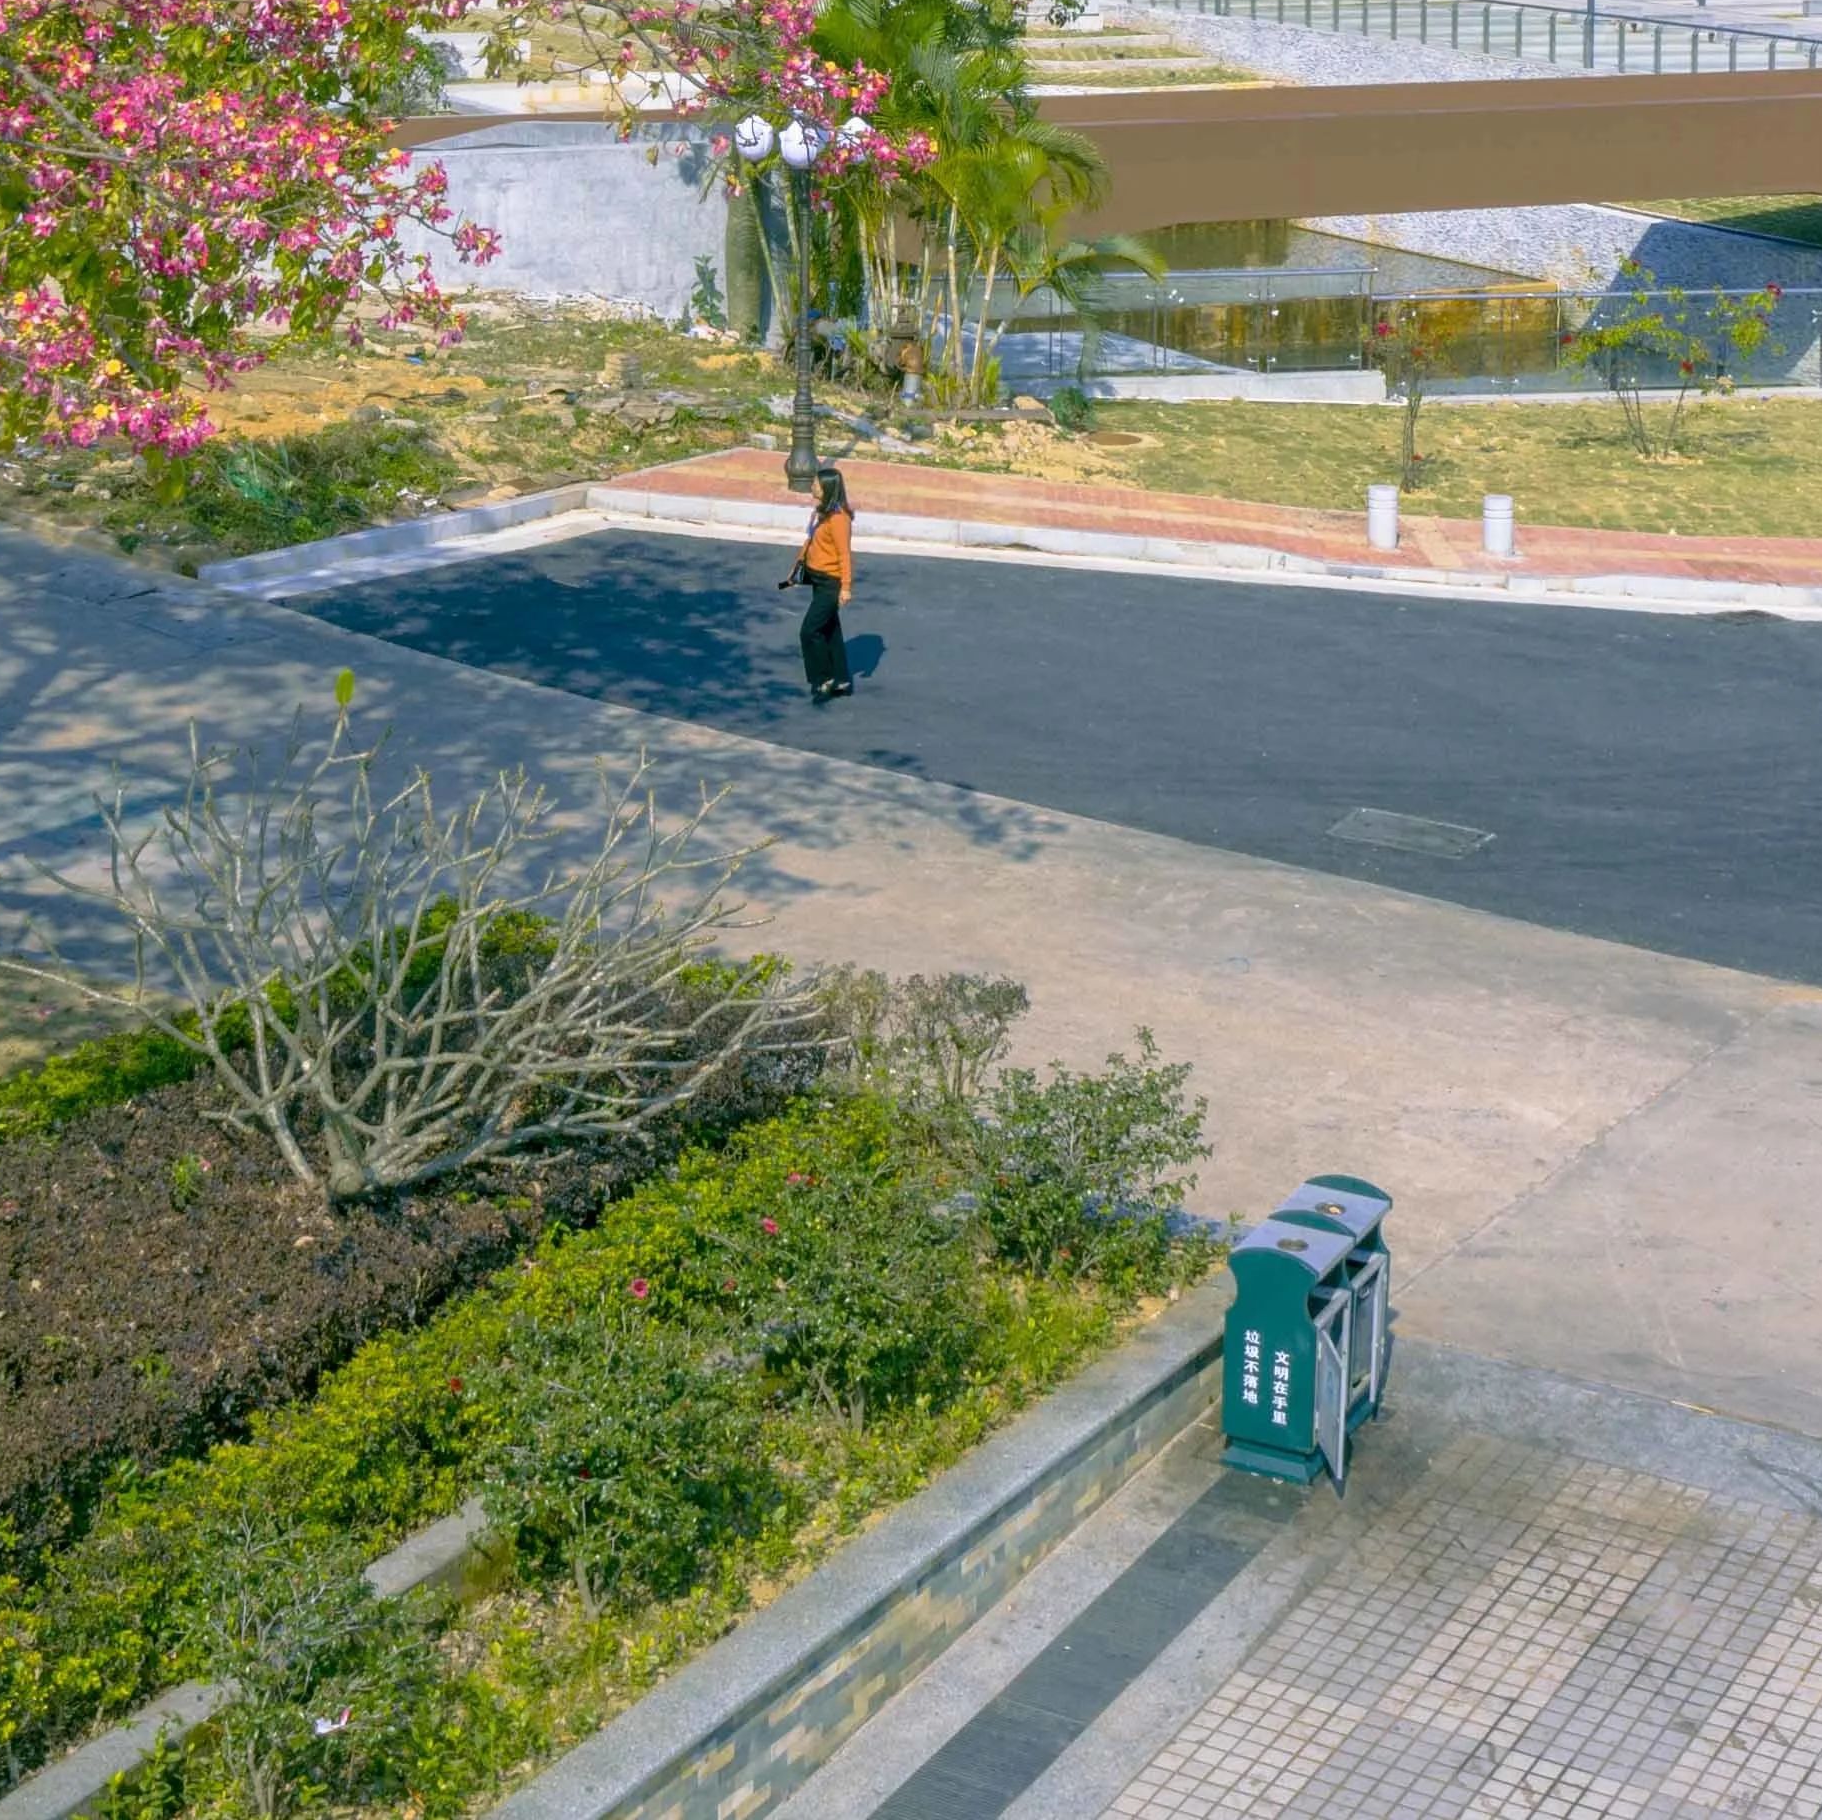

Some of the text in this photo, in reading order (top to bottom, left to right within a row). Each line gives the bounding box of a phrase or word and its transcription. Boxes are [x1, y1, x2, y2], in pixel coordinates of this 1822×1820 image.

[1242, 1329, 1260, 1405] 垃圾不落地
[1271, 1351, 1290, 1426] 文明在手里
